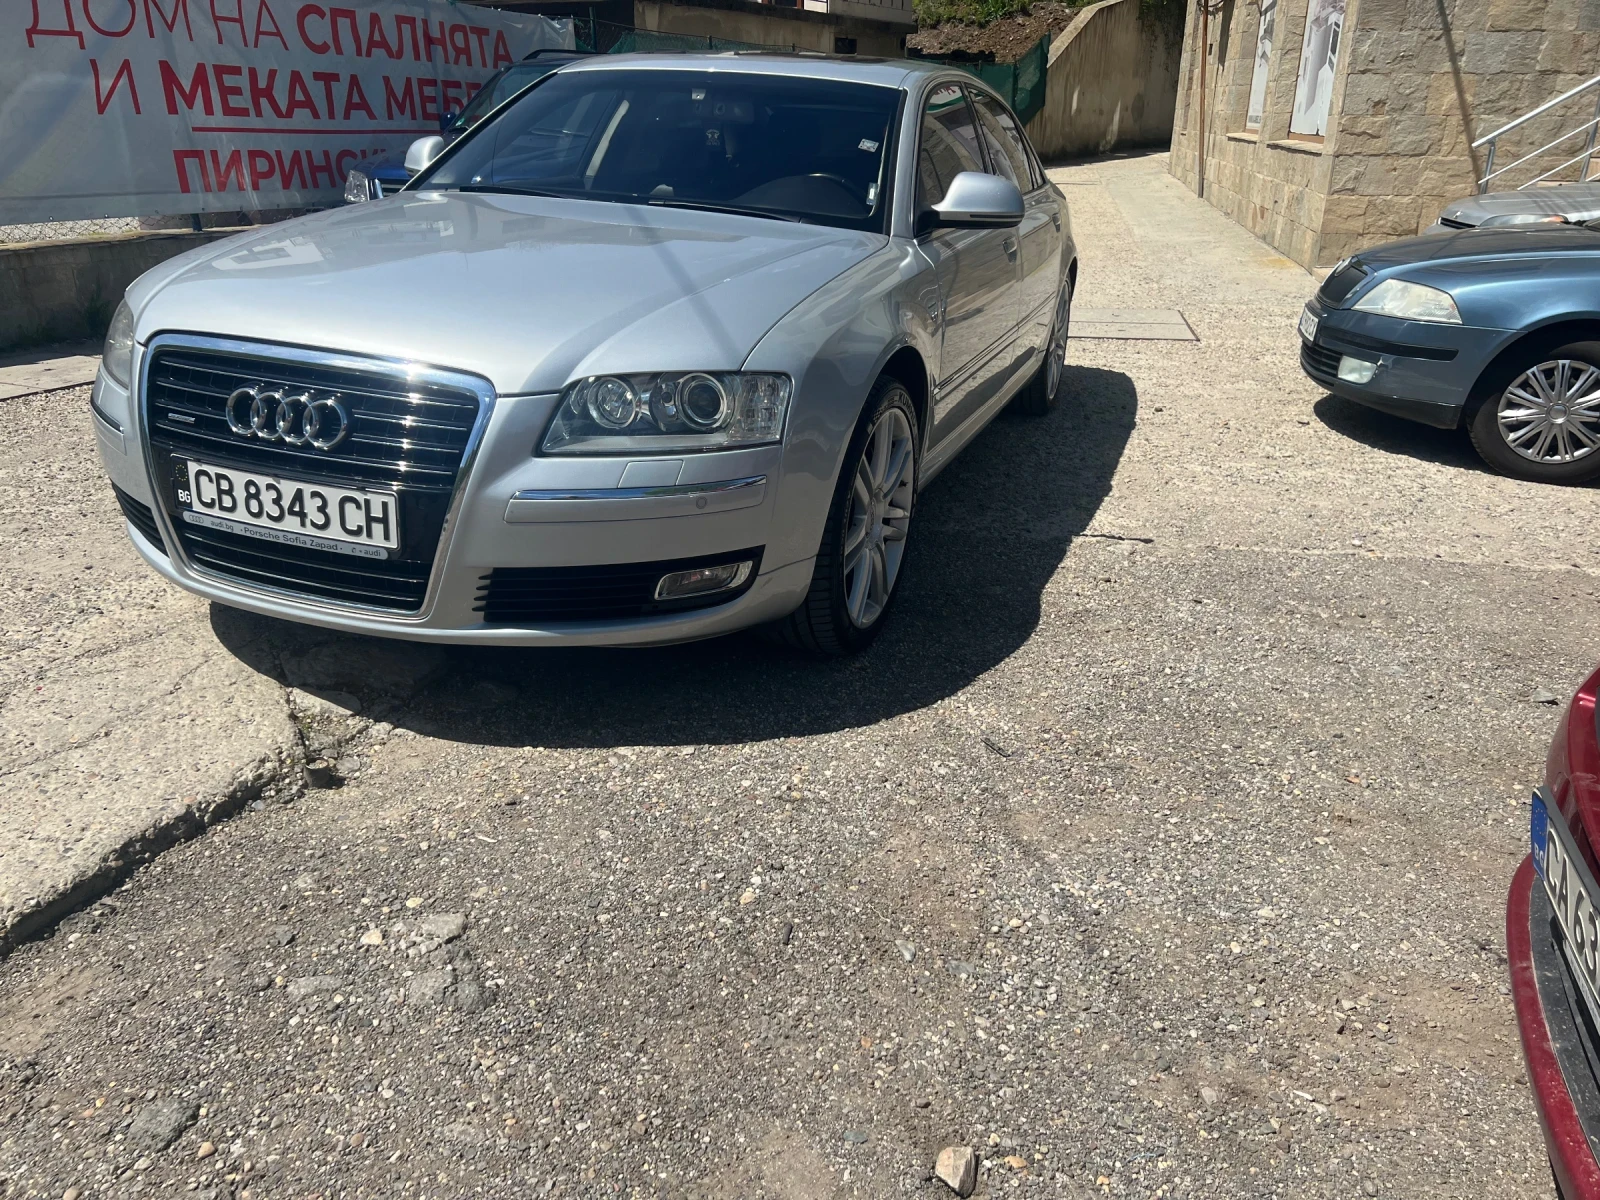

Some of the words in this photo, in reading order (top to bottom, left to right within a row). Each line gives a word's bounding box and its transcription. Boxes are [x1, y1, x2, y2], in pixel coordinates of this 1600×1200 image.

[25, 0, 194, 50] ДОМ
[210, 0, 290, 51] НА
[296, 3, 514, 70] СПАЛНЯТА
[90, 58, 141, 115] И
[158, 59, 378, 121] МЕКАТА
[173, 149, 386, 194] ПИРИНС
[177, 489, 191, 503] BG
[195, 469, 237, 513] CB
[244, 478, 332, 532] 8343
[338, 494, 391, 541] CH
[210, 520, 234, 533] audi.bg
[244, 526, 281, 541] Porsche
[282, 534, 307, 546] Sofia
[309, 538, 338, 552] Zapad
[1534, 842, 1544, 868] BG
[1545, 828, 1569, 928] CA
[1573, 886, 1600, 987] 63
